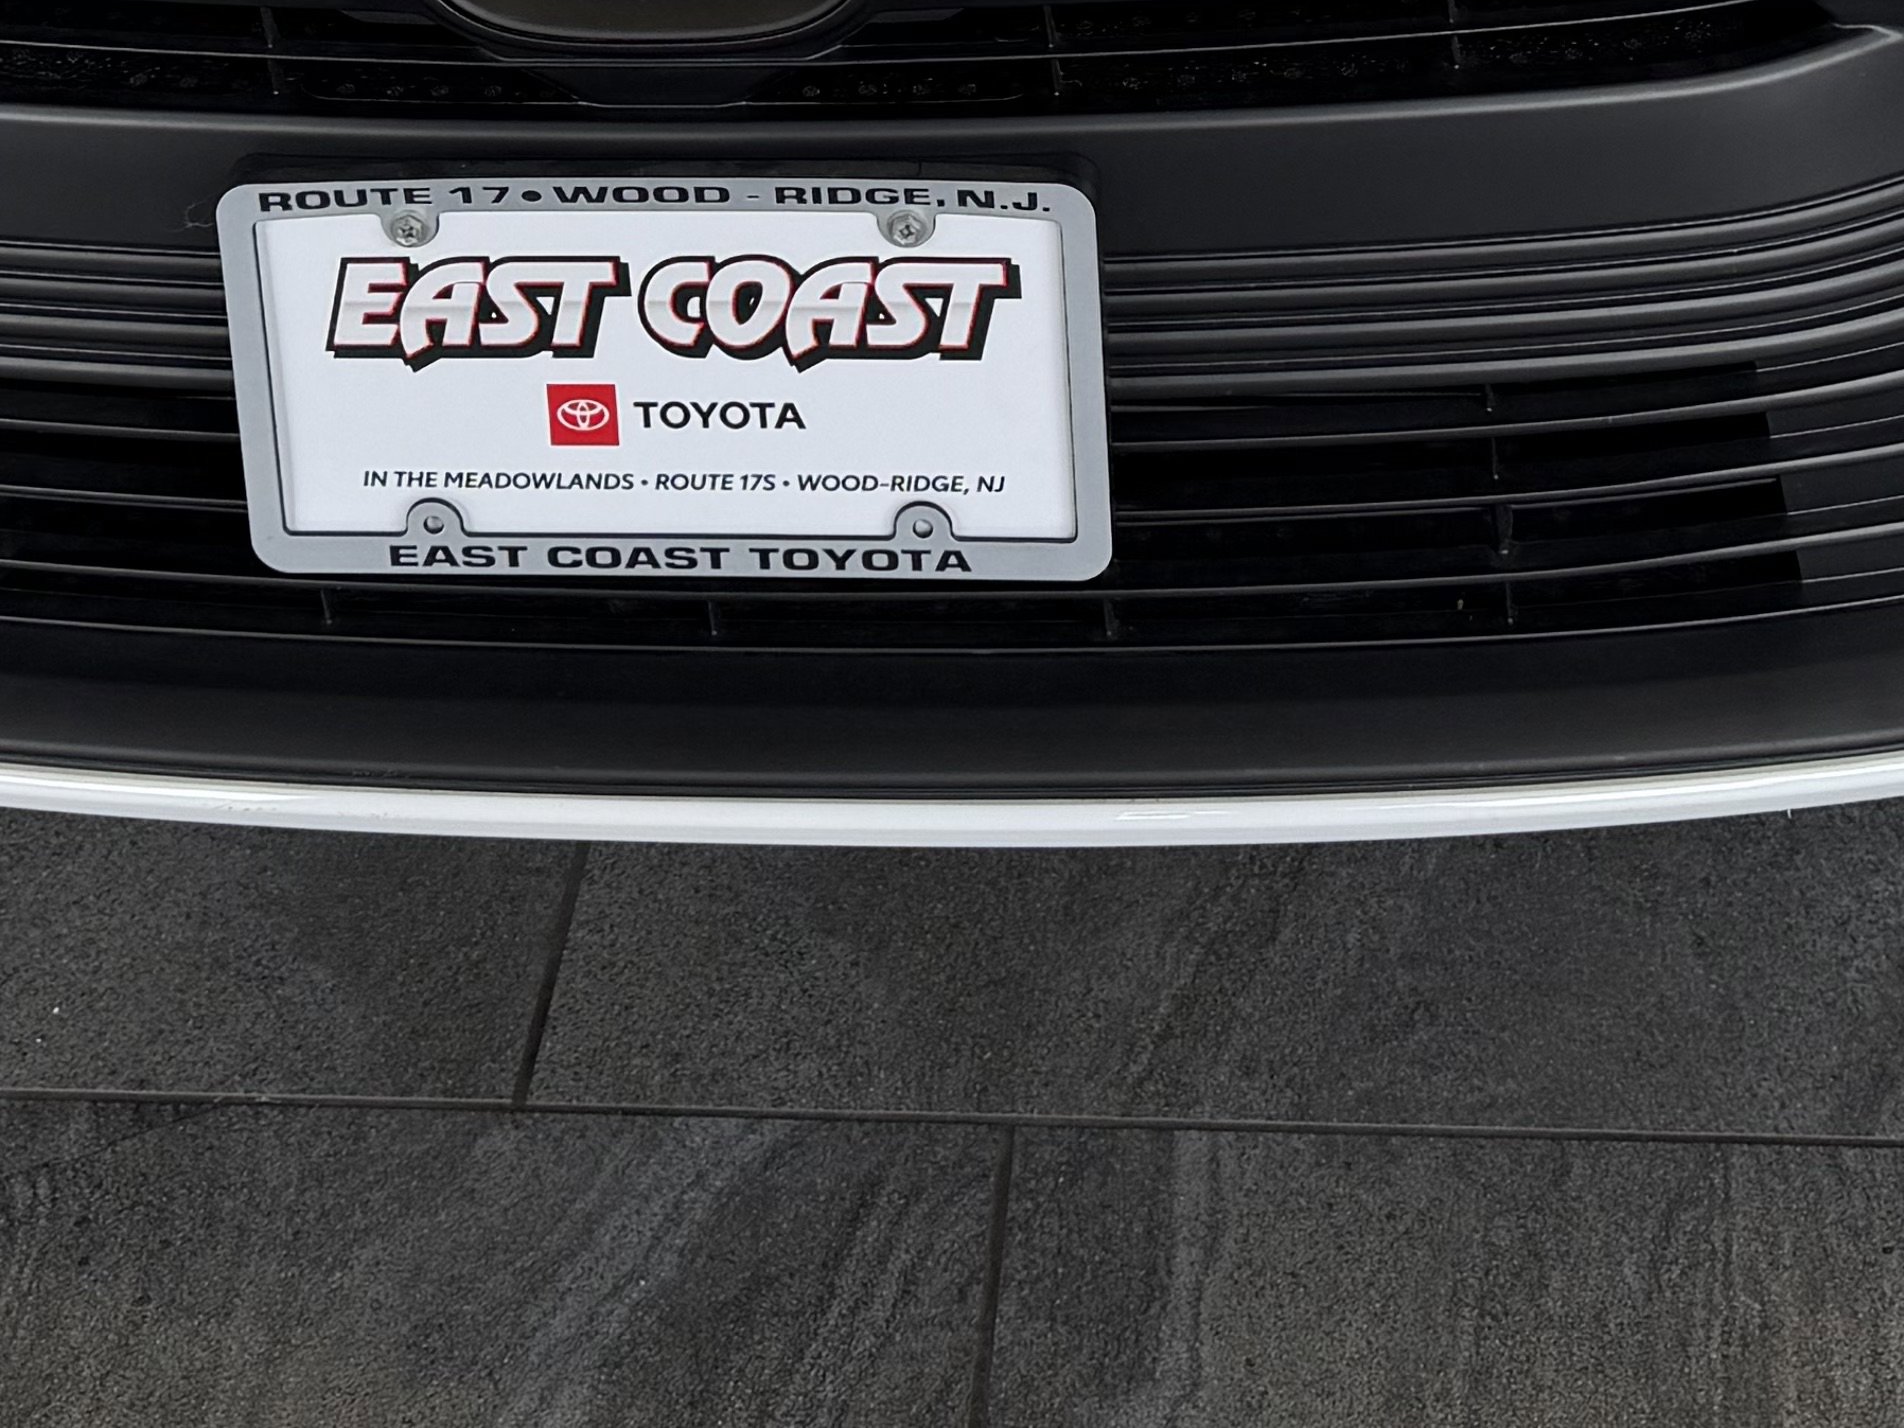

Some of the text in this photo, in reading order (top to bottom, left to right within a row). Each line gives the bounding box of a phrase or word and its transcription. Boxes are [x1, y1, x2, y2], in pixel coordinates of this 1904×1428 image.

[258, 187, 432, 211] ROUTE
[957, 190, 1051, 211] N.J.
[326, 254, 1022, 372] EAST COAST
[634, 401, 806, 430] TOYOTA
[363, 470, 1006, 495] IN THE MEADOWLANDS ROUTE 17S WOOD-RIDGE, NJ
[388, 545, 972, 572] EAST COAST TOYOTA
